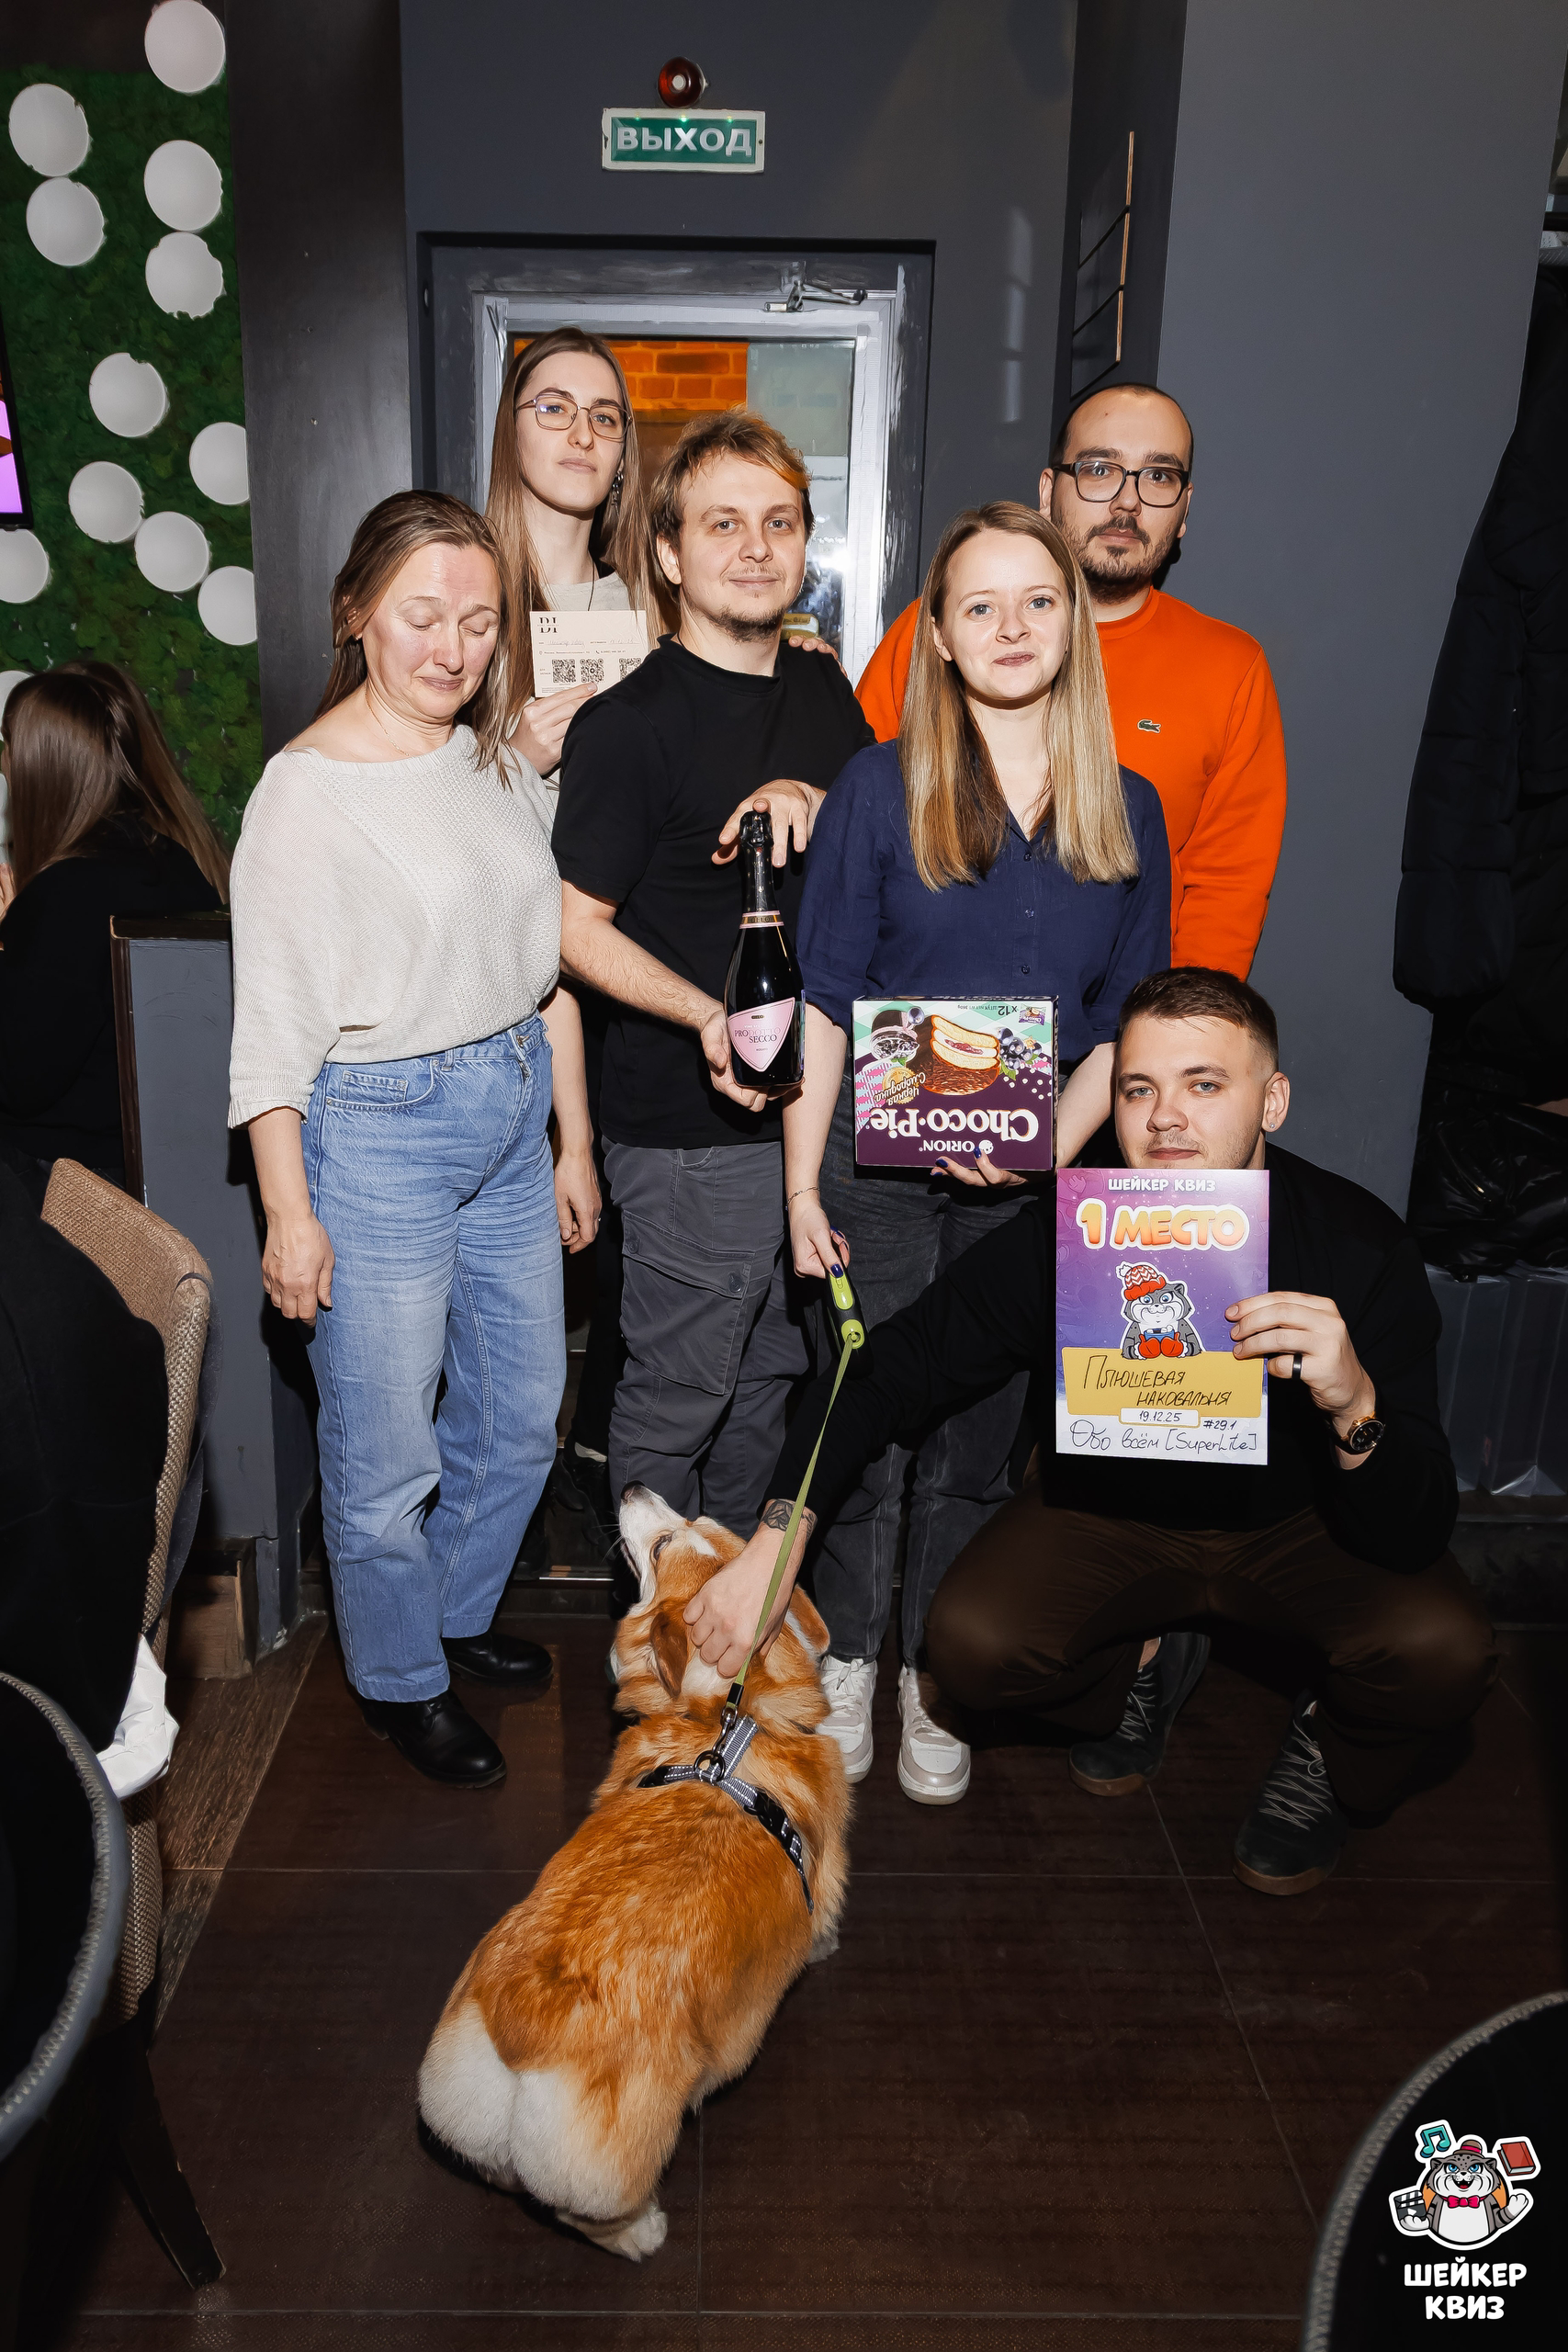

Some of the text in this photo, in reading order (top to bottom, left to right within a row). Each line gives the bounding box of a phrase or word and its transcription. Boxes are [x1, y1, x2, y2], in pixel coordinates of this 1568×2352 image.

[617, 127, 752, 157] ВЫХОД
[749, 1035, 777, 1044] SECCO
[923, 1139, 976, 1153] ORION
[1108, 1175, 1216, 1192] ШЕЙКЕР КВИЗ
[1081, 1203, 1245, 1247] 1 МЕСТО
[1139, 1410, 1182, 1422] 19.12.25
[1203, 1419, 1237, 1430] #29.1
[1070, 1419, 1111, 1451] Обо
